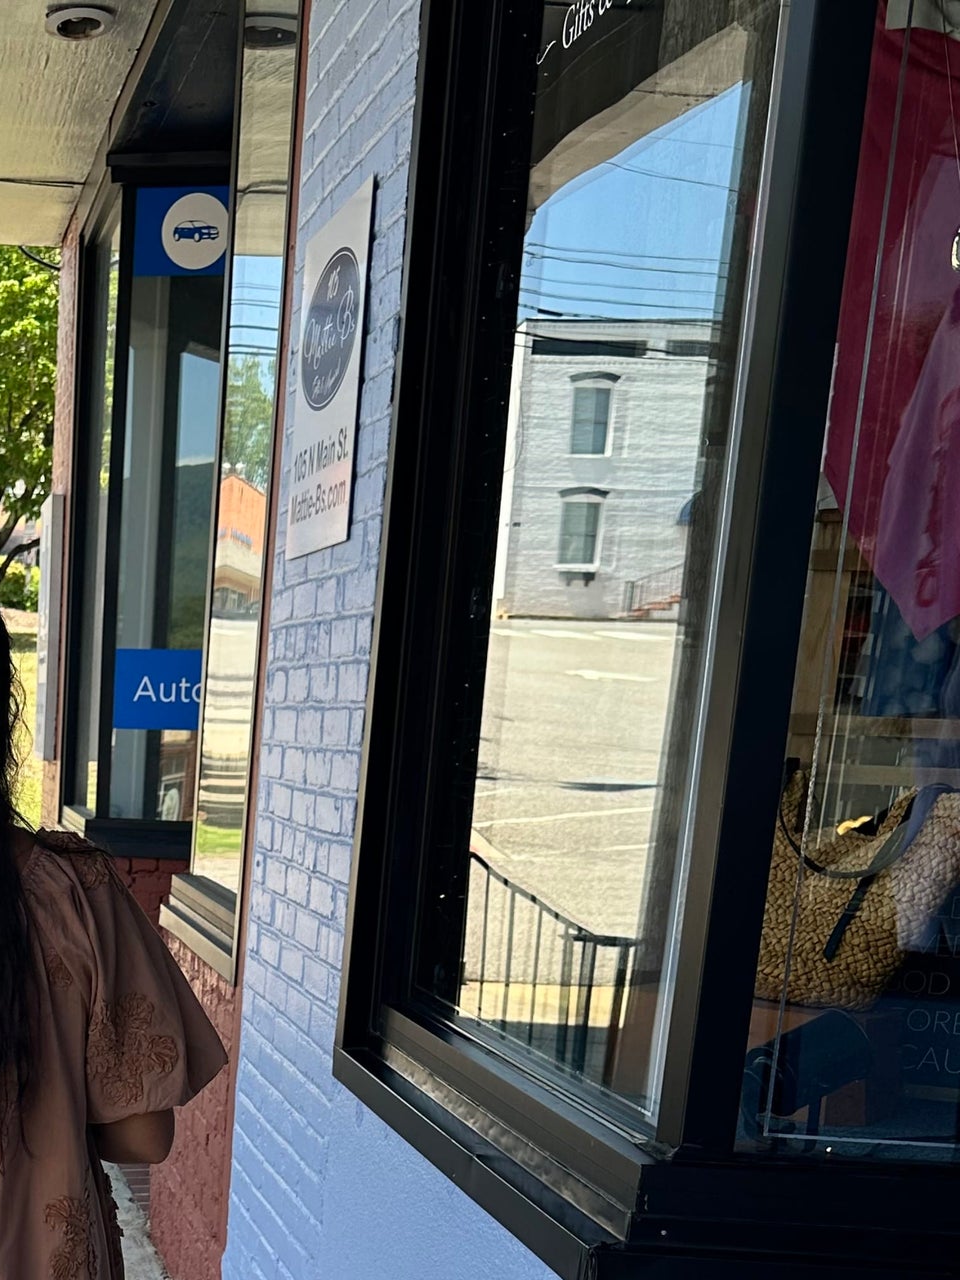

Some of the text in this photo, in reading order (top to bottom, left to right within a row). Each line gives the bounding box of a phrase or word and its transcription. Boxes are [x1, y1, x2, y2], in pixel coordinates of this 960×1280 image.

[562, 0, 595, 49] Gifts
[304, 314, 337, 370] Mattie
[293, 448, 308, 484] 105
[307, 442, 316, 478] N
[315, 434, 336, 474] Main
[290, 479, 346, 525] Mattie-Bs.com
